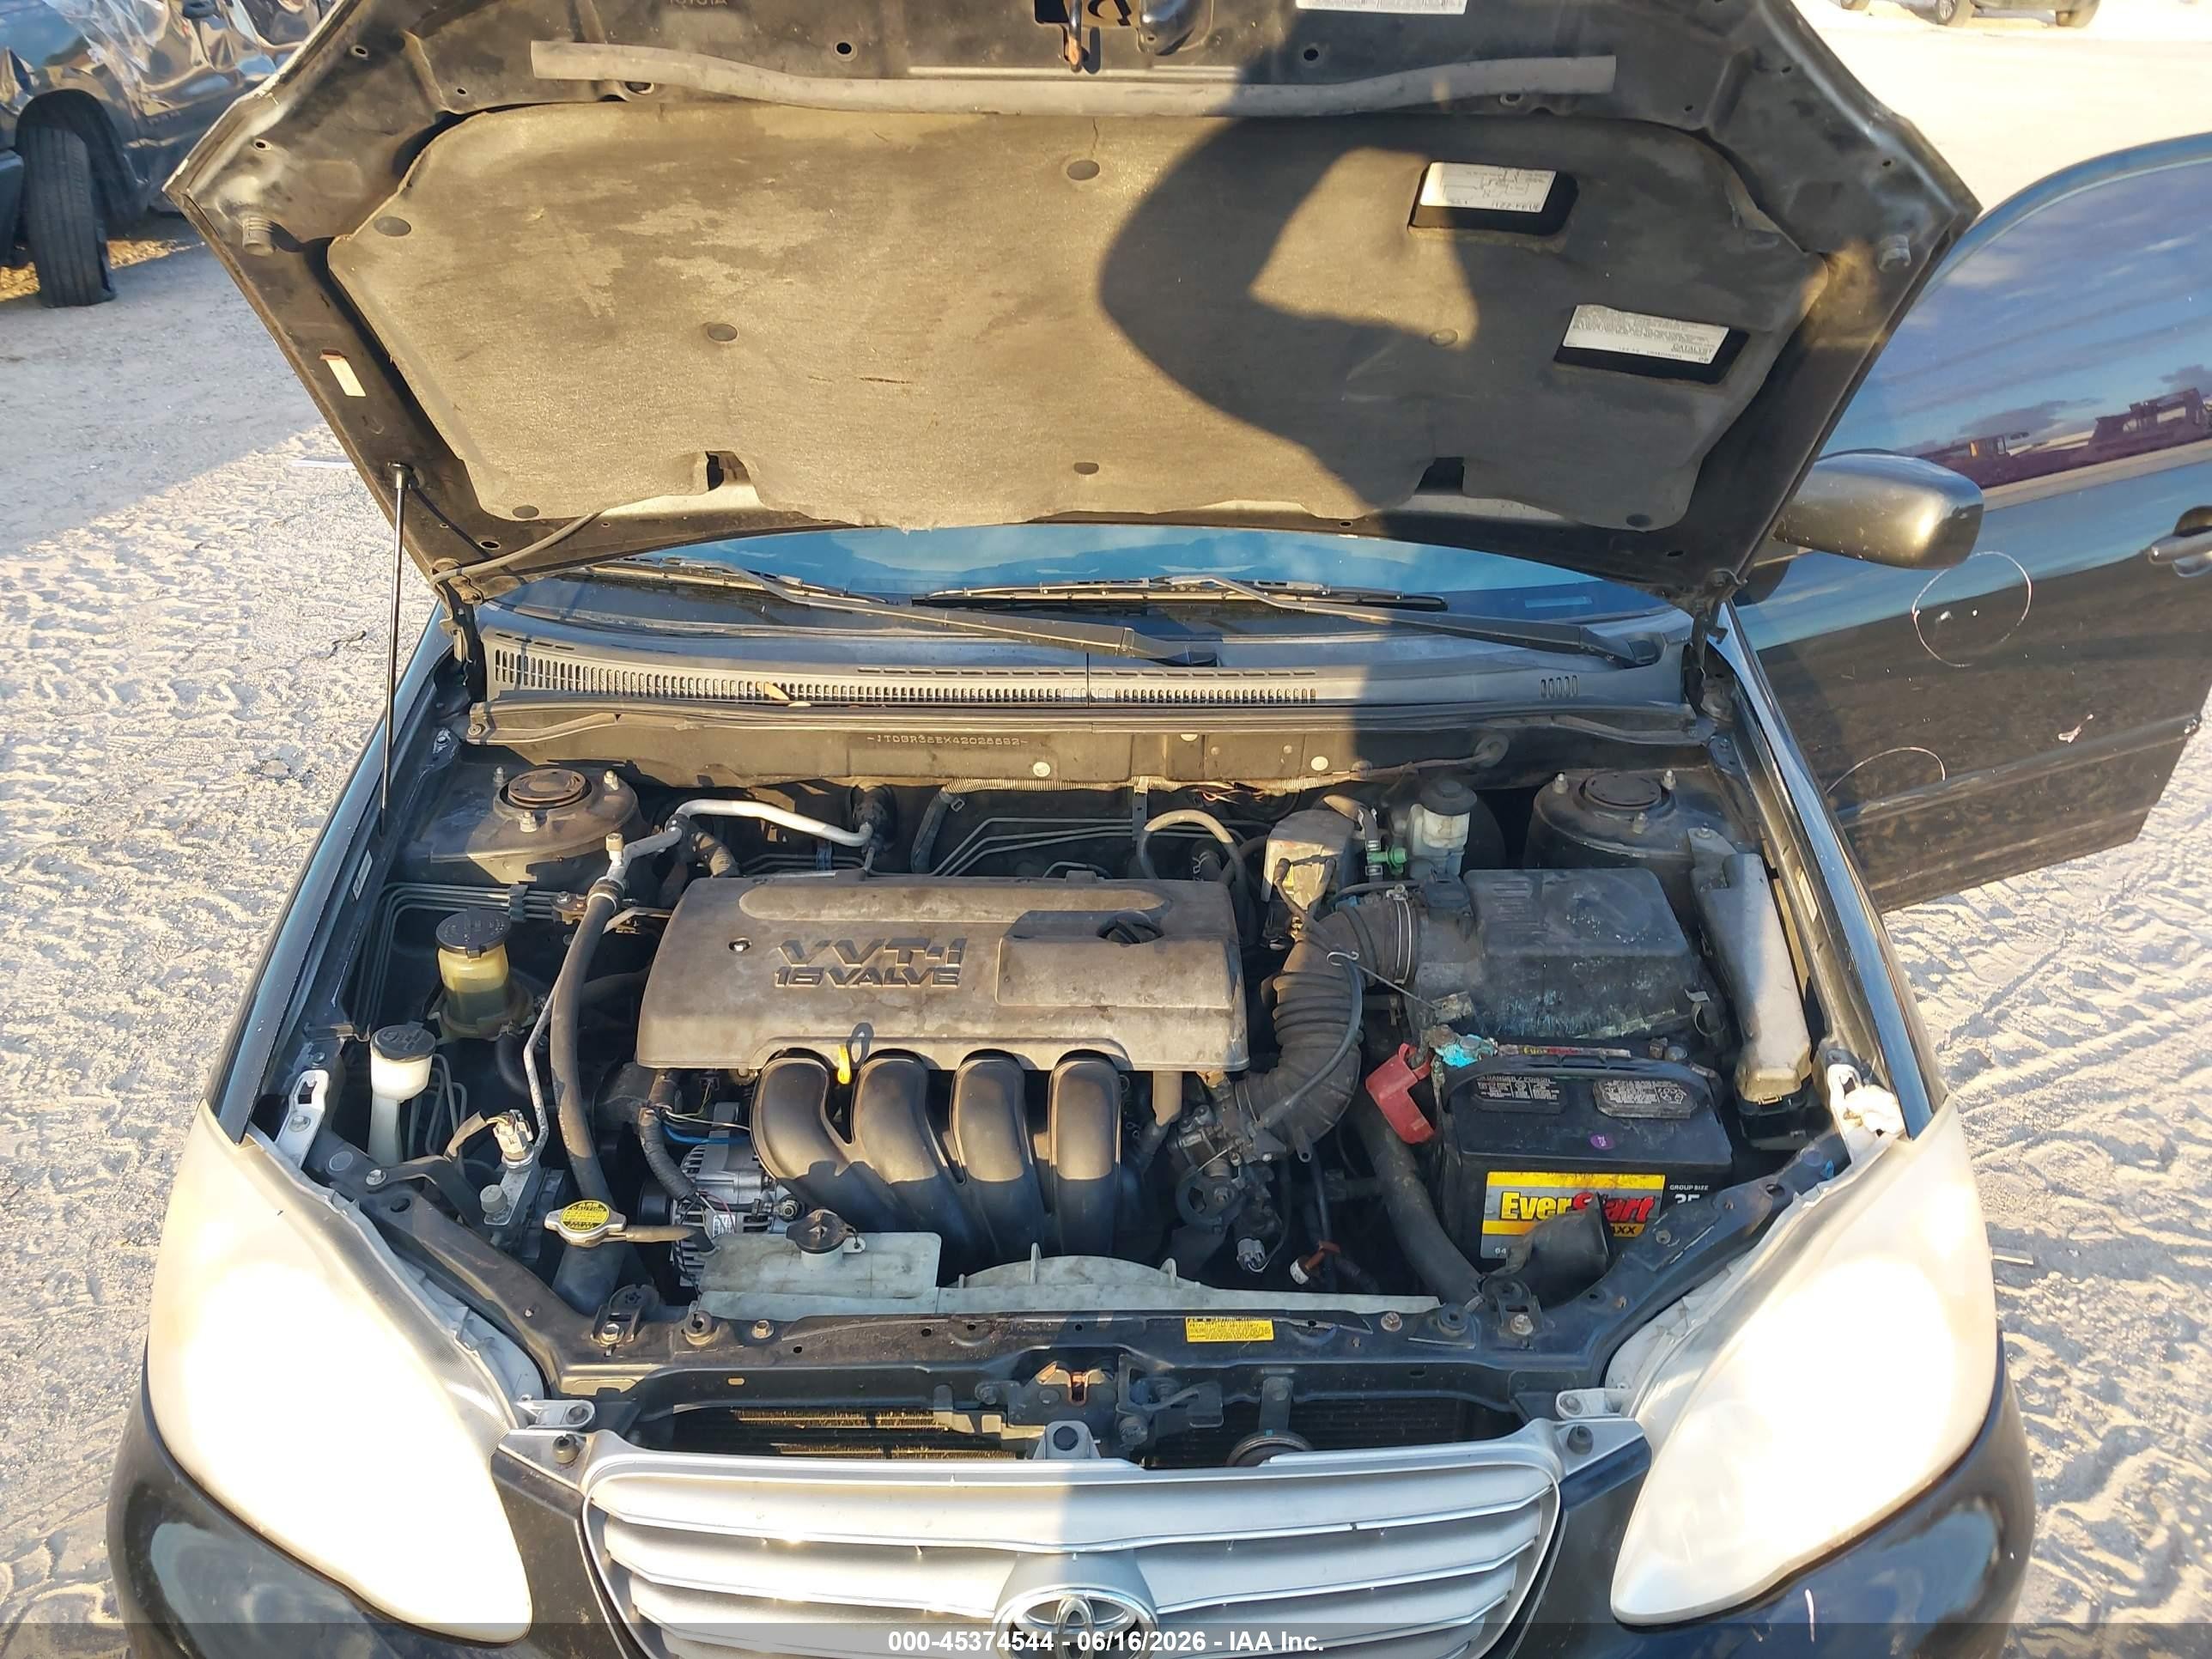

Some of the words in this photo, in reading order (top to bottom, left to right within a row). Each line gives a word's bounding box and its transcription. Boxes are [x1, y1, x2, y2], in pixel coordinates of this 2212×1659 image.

[775, 967, 824, 988] 16
[826, 967, 962, 988] VALVE
[1500, 1191, 1656, 1222] EverSart
